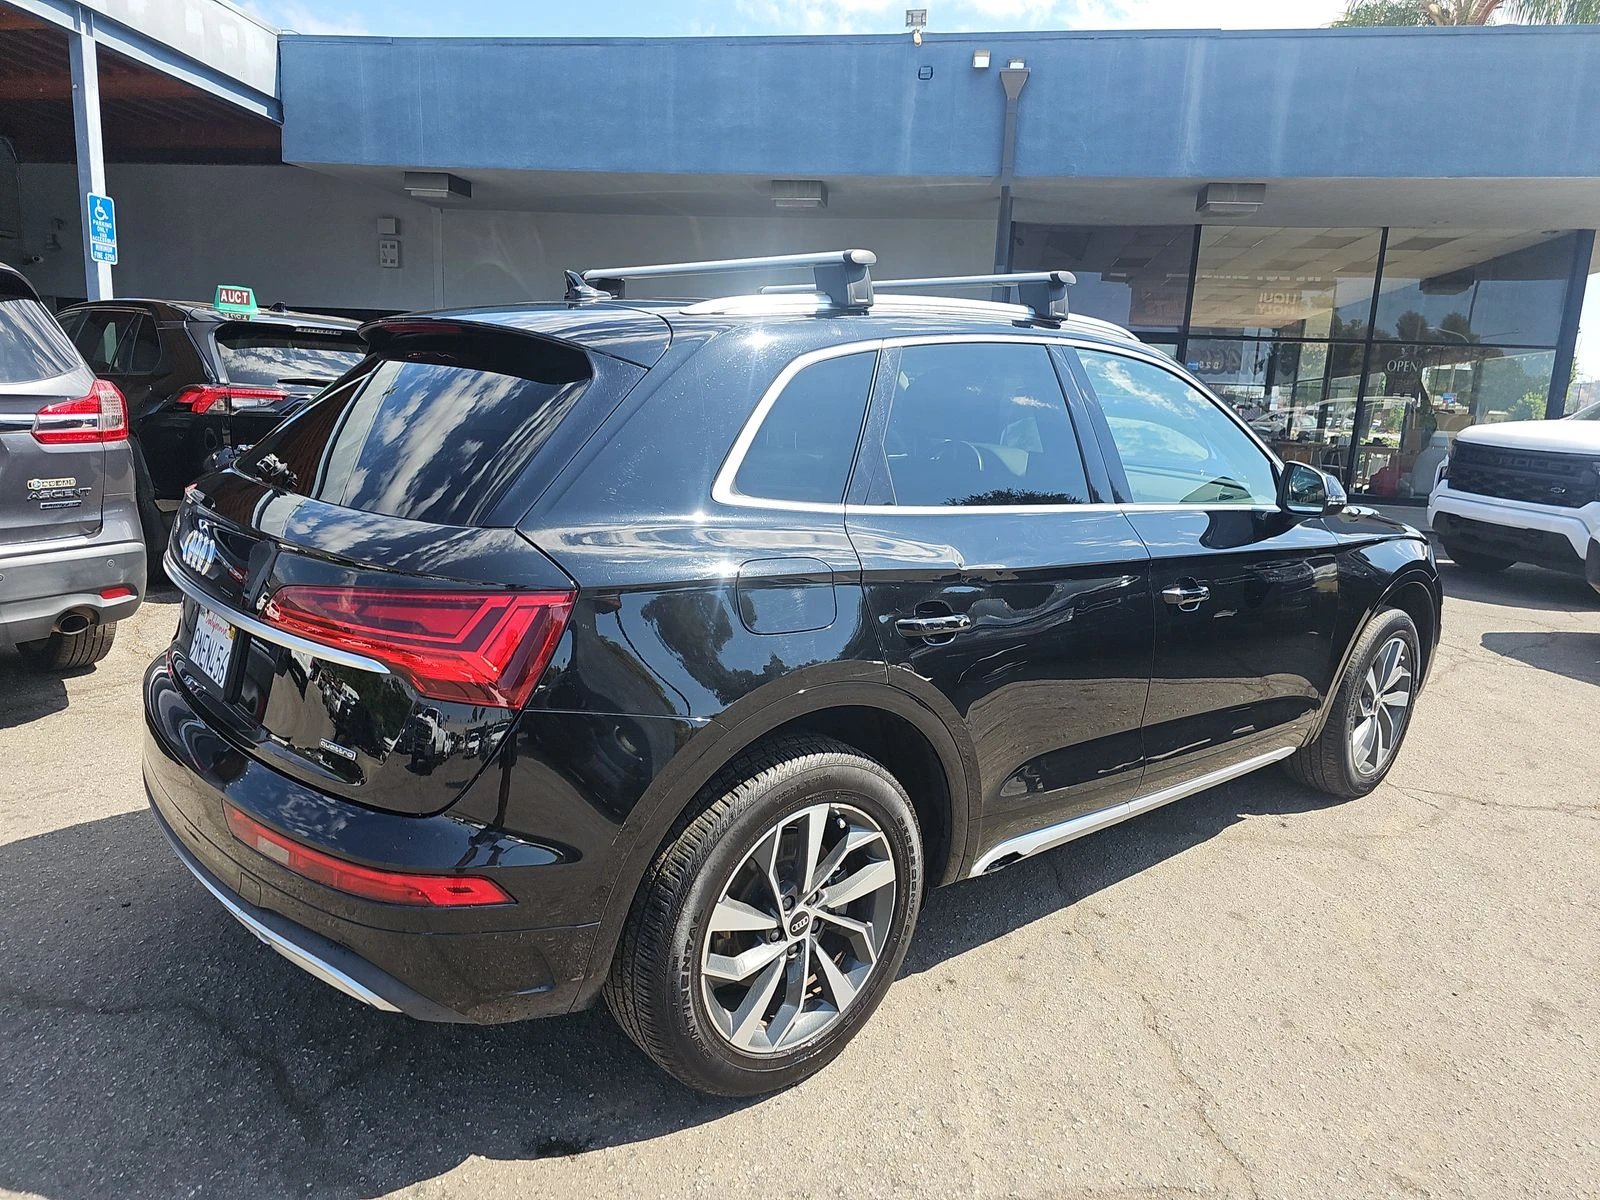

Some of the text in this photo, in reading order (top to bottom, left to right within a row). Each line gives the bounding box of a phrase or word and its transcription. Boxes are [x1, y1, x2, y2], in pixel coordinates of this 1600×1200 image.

[92, 219, 112, 229] PARKING
[97, 225, 109, 234] ONLY
[94, 250, 104, 260] FINE
[220, 289, 249, 304] AUCT
[1387, 359, 1420, 372] OPEN
[27, 487, 92, 500] ASCENT
[320, 740, 354, 759] quattro
[681, 909, 712, 1061] CONTINENTAL
